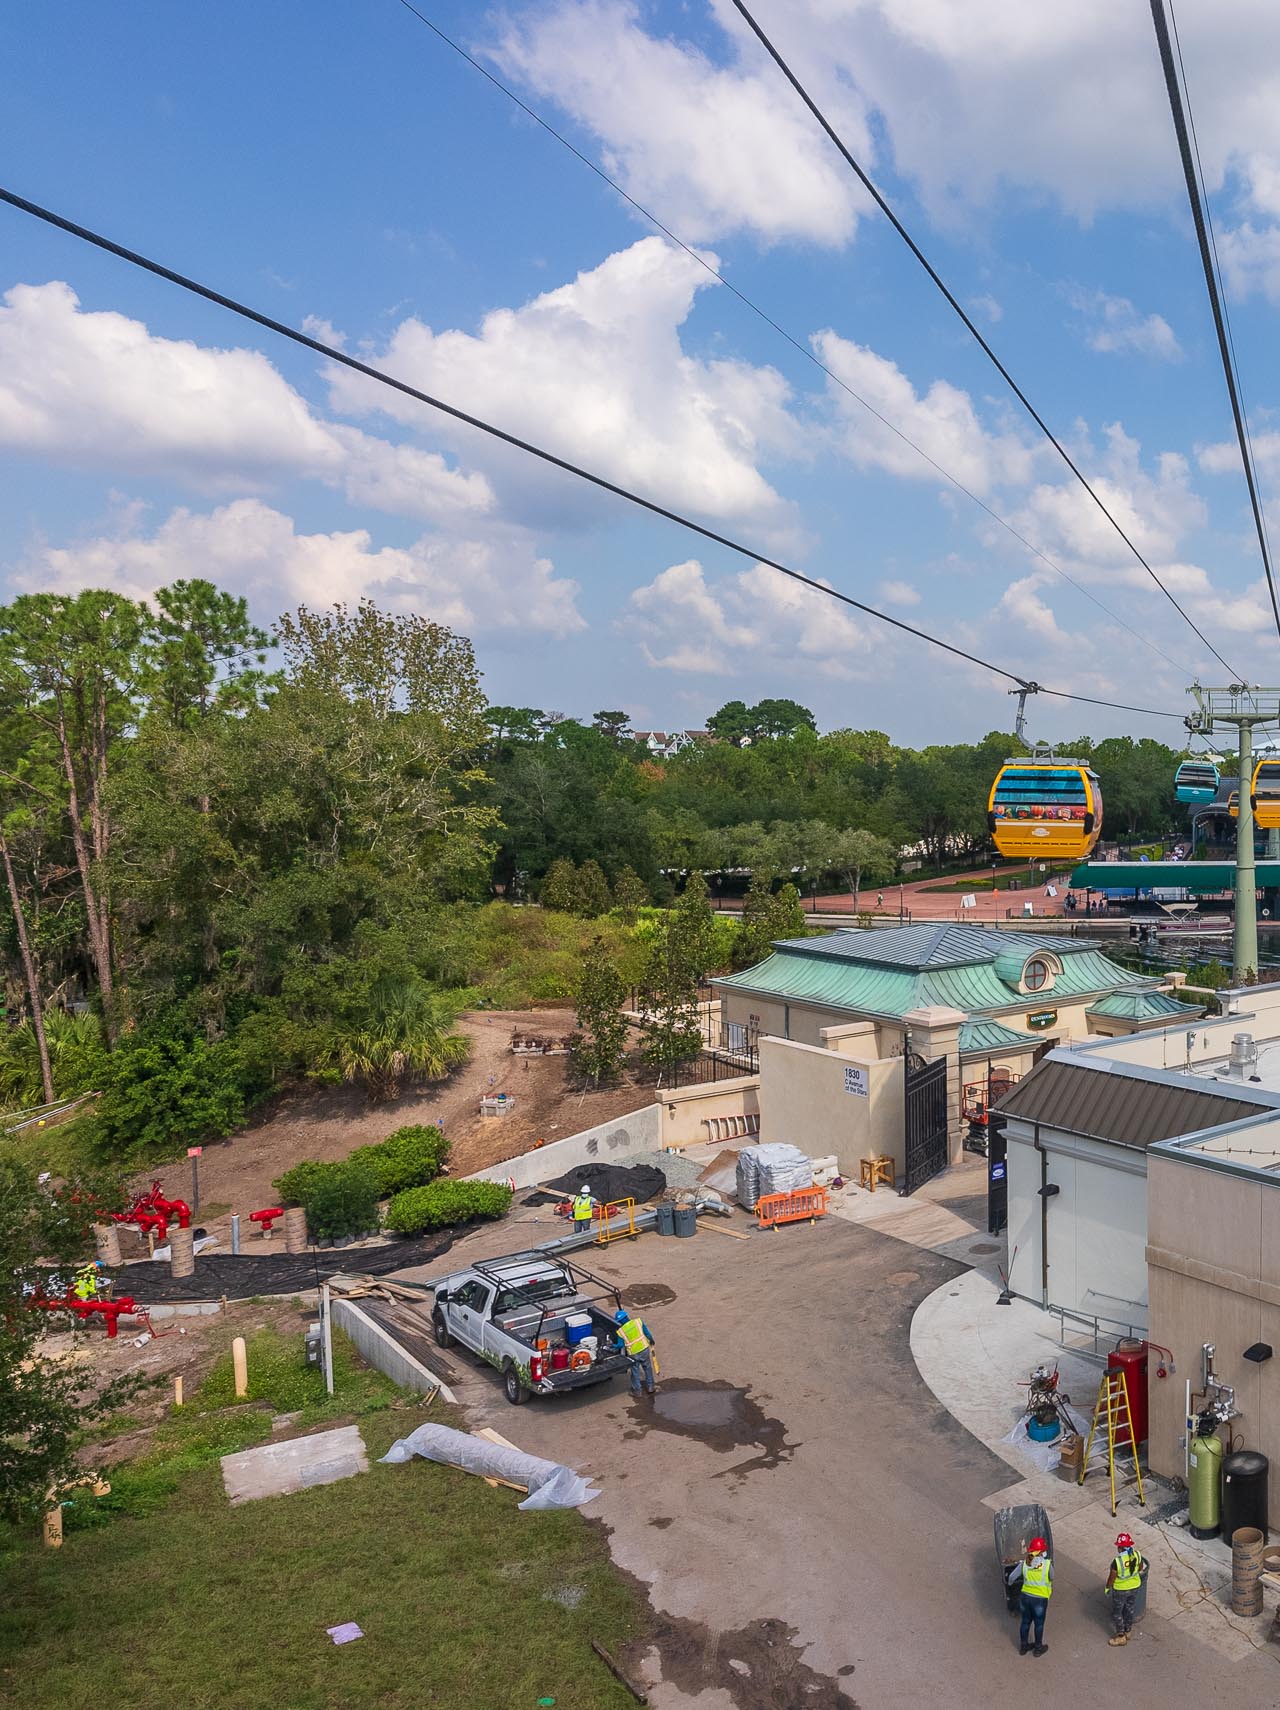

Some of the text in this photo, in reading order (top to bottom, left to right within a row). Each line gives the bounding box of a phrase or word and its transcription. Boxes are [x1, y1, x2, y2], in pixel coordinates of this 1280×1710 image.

[845, 1068, 860, 1080] 1830
[849, 1080, 863, 1088] Avenue
[857, 1088, 867, 1096] Stars
